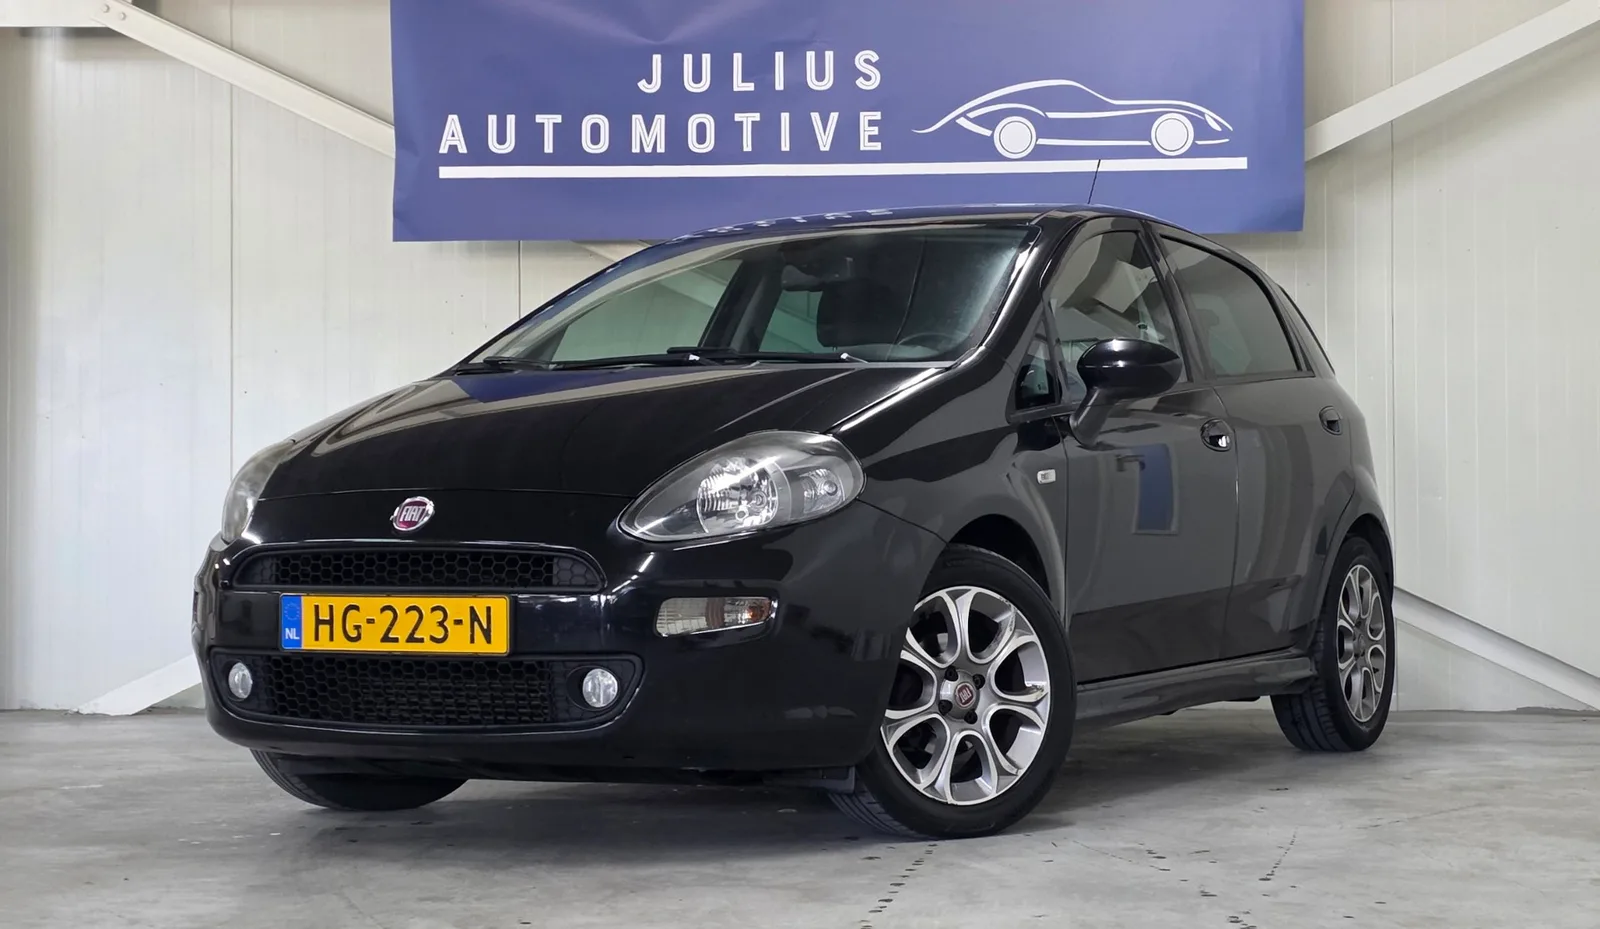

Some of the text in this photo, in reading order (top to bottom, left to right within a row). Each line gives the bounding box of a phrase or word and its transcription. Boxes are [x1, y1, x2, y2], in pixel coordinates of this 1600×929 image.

[638, 50, 881, 94] JULIUS
[439, 111, 882, 154] AUTOMOTIVE
[399, 505, 426, 522] FIAT
[284, 628, 300, 640] NL
[313, 604, 492, 644] HG-223-N
